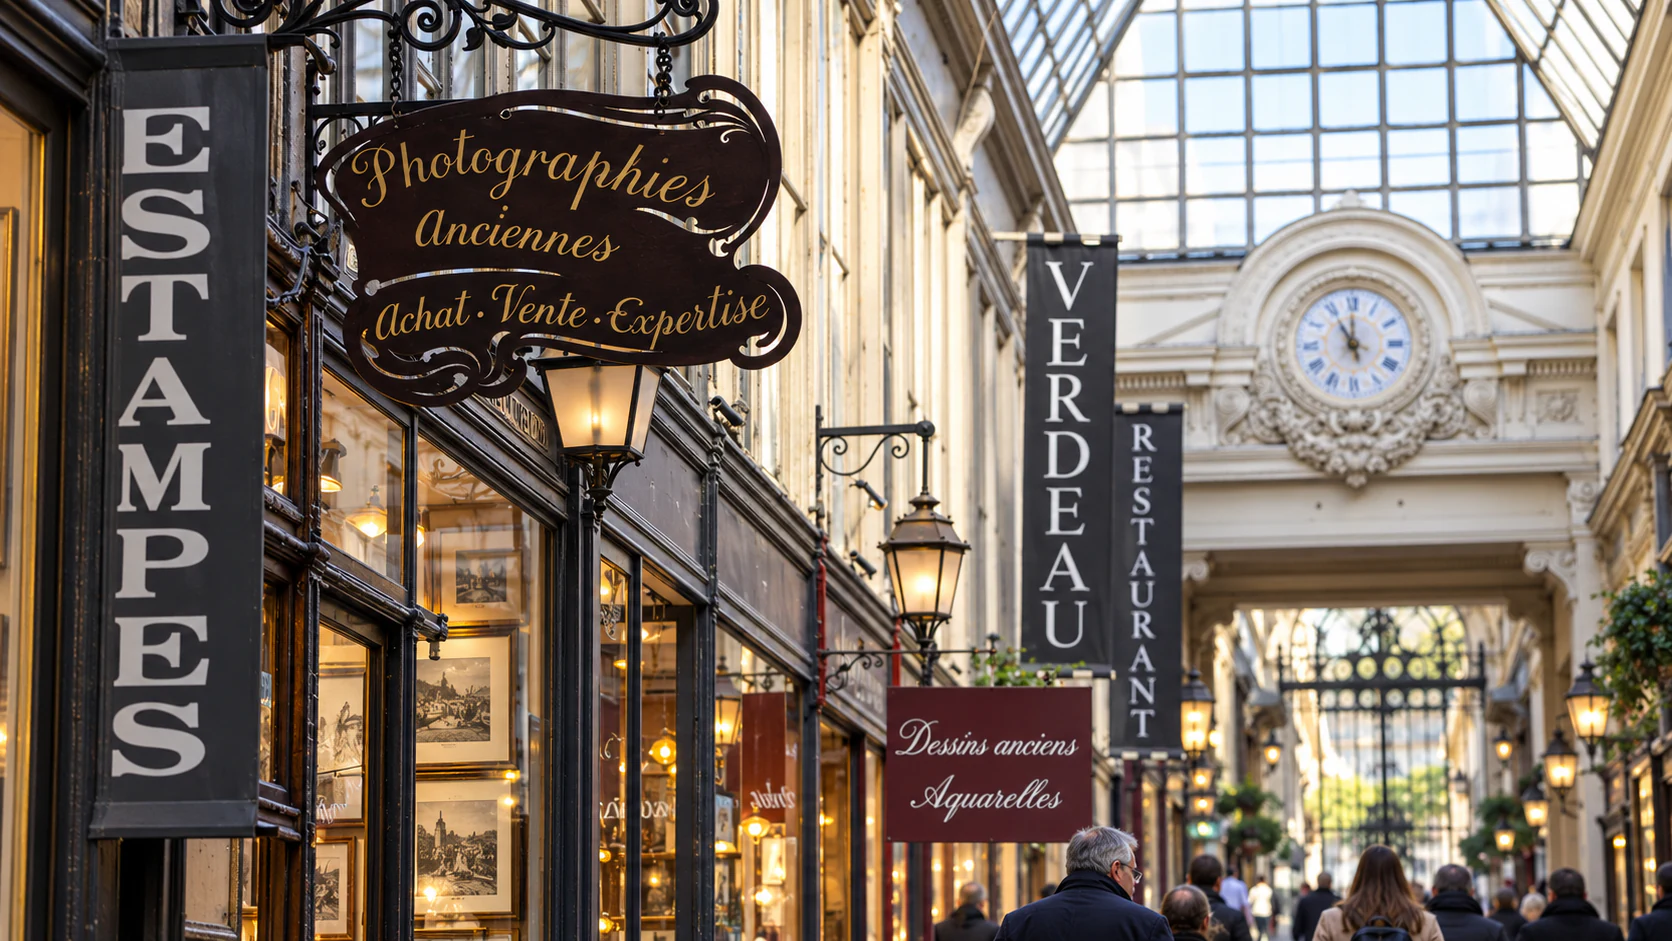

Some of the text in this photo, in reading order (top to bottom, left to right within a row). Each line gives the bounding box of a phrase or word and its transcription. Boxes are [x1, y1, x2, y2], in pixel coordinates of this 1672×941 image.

[351, 129, 716, 211] Photographies
[414, 205, 621, 262] Anciennes
[374, 283, 771, 350] Achat Vente Expertise
[111, 106, 212, 777] ESTAMPES
[1039, 260, 1094, 648] VERDEAU
[1128, 423, 1157, 739] RESTAURANT
[895, 718, 1080, 757] Dessins anciens
[910, 774, 1063, 823] Aquarelles
